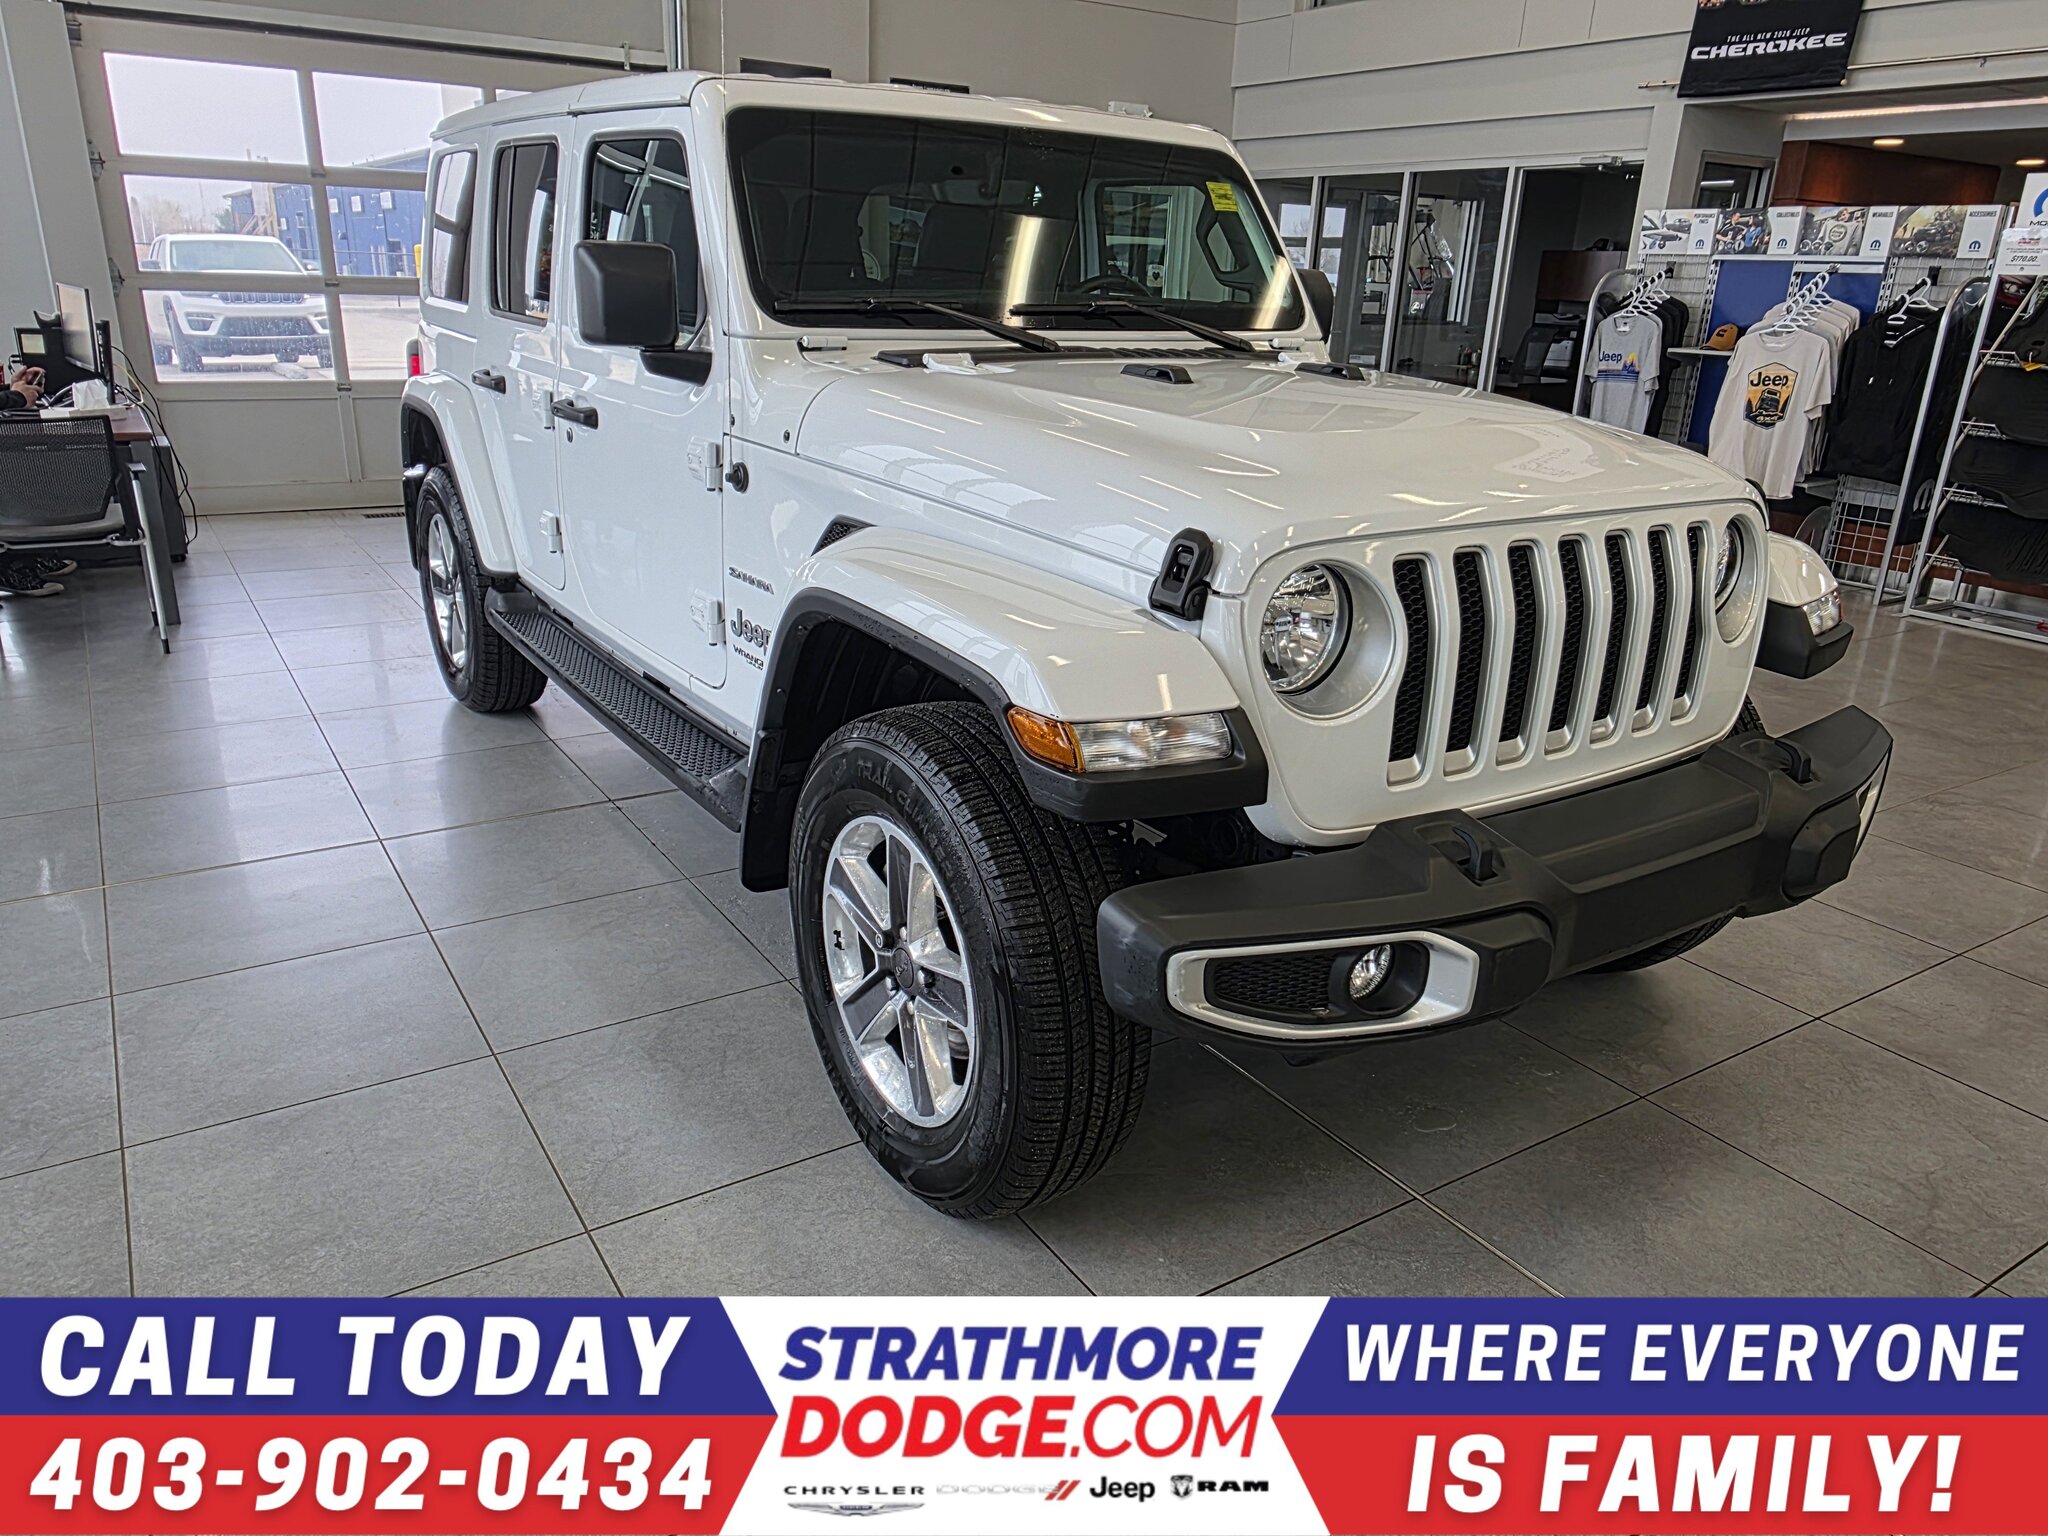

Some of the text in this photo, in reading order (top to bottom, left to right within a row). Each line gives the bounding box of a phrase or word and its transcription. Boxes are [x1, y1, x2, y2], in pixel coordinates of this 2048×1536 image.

[1727, 35, 1741, 43] THE
[1757, 32, 1772, 40] NEW
[1793, 27, 1810, 36] JEEP
[1690, 32, 1848, 60] CHEROKEE
[1599, 351, 1622, 364] Jeep
[1750, 371, 1789, 389] Jeep
[733, 644, 764, 667] WRANG
